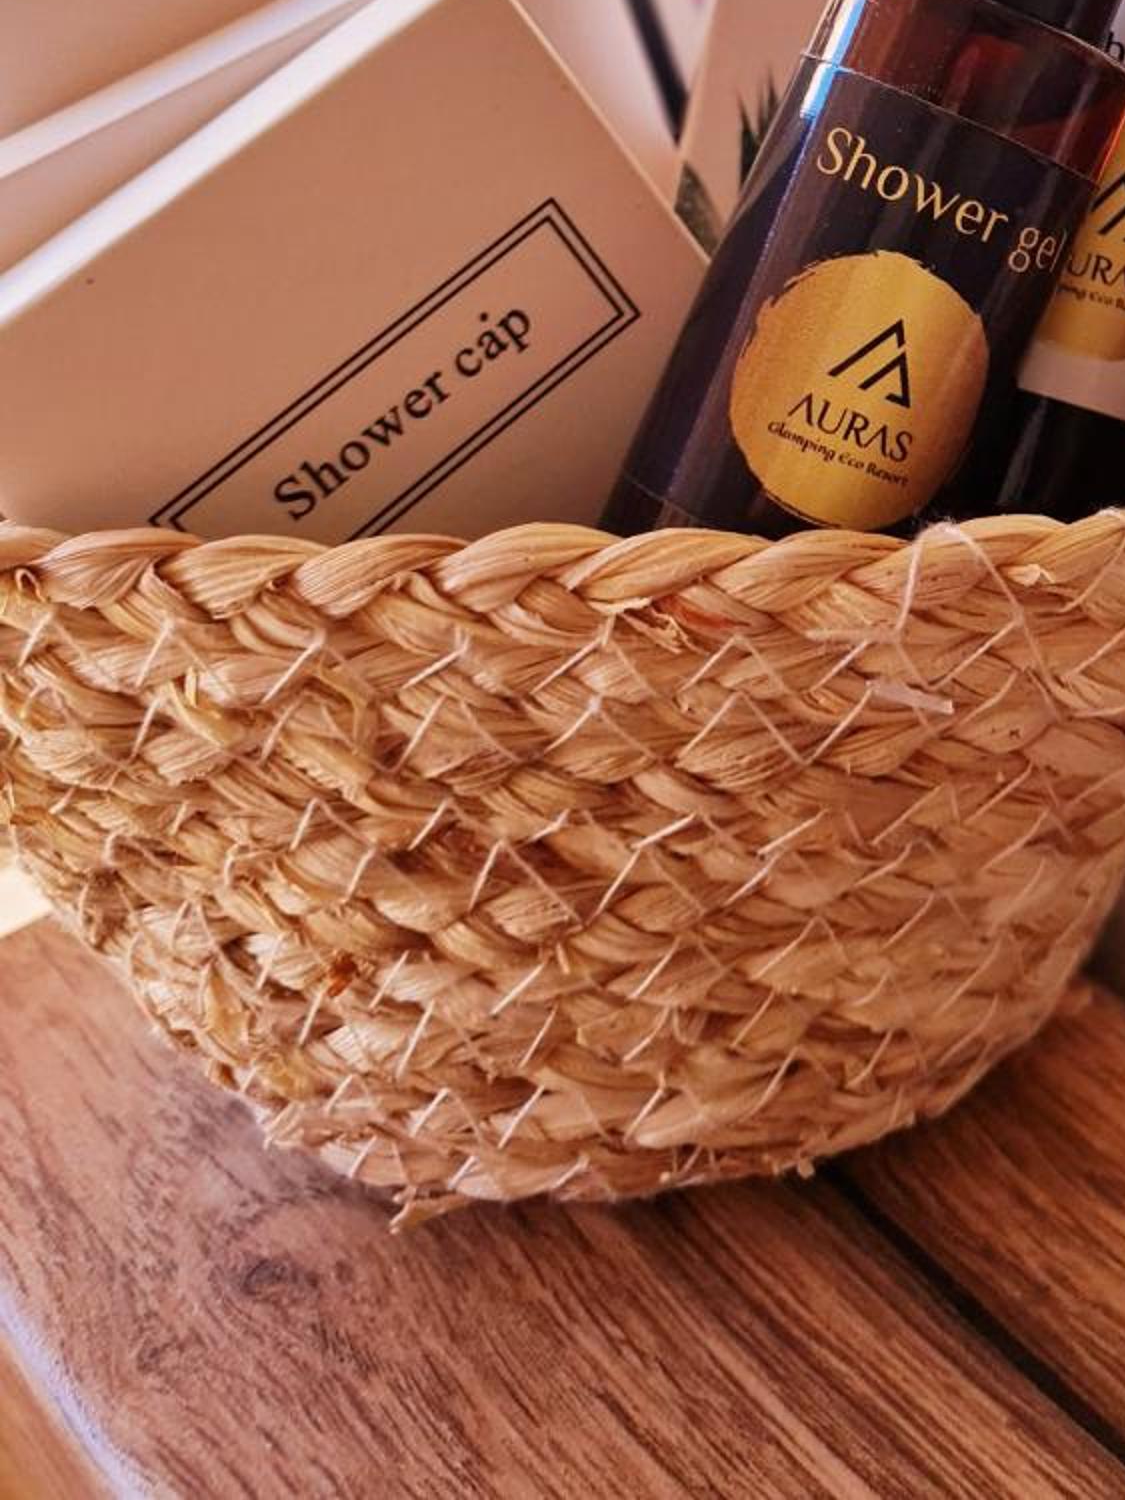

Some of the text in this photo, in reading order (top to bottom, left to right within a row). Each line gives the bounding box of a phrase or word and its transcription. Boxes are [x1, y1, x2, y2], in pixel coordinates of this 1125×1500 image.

[817, 127, 1068, 274] Shower gel
[273, 371, 450, 521] Shower
[787, 392, 913, 463] AURAS
